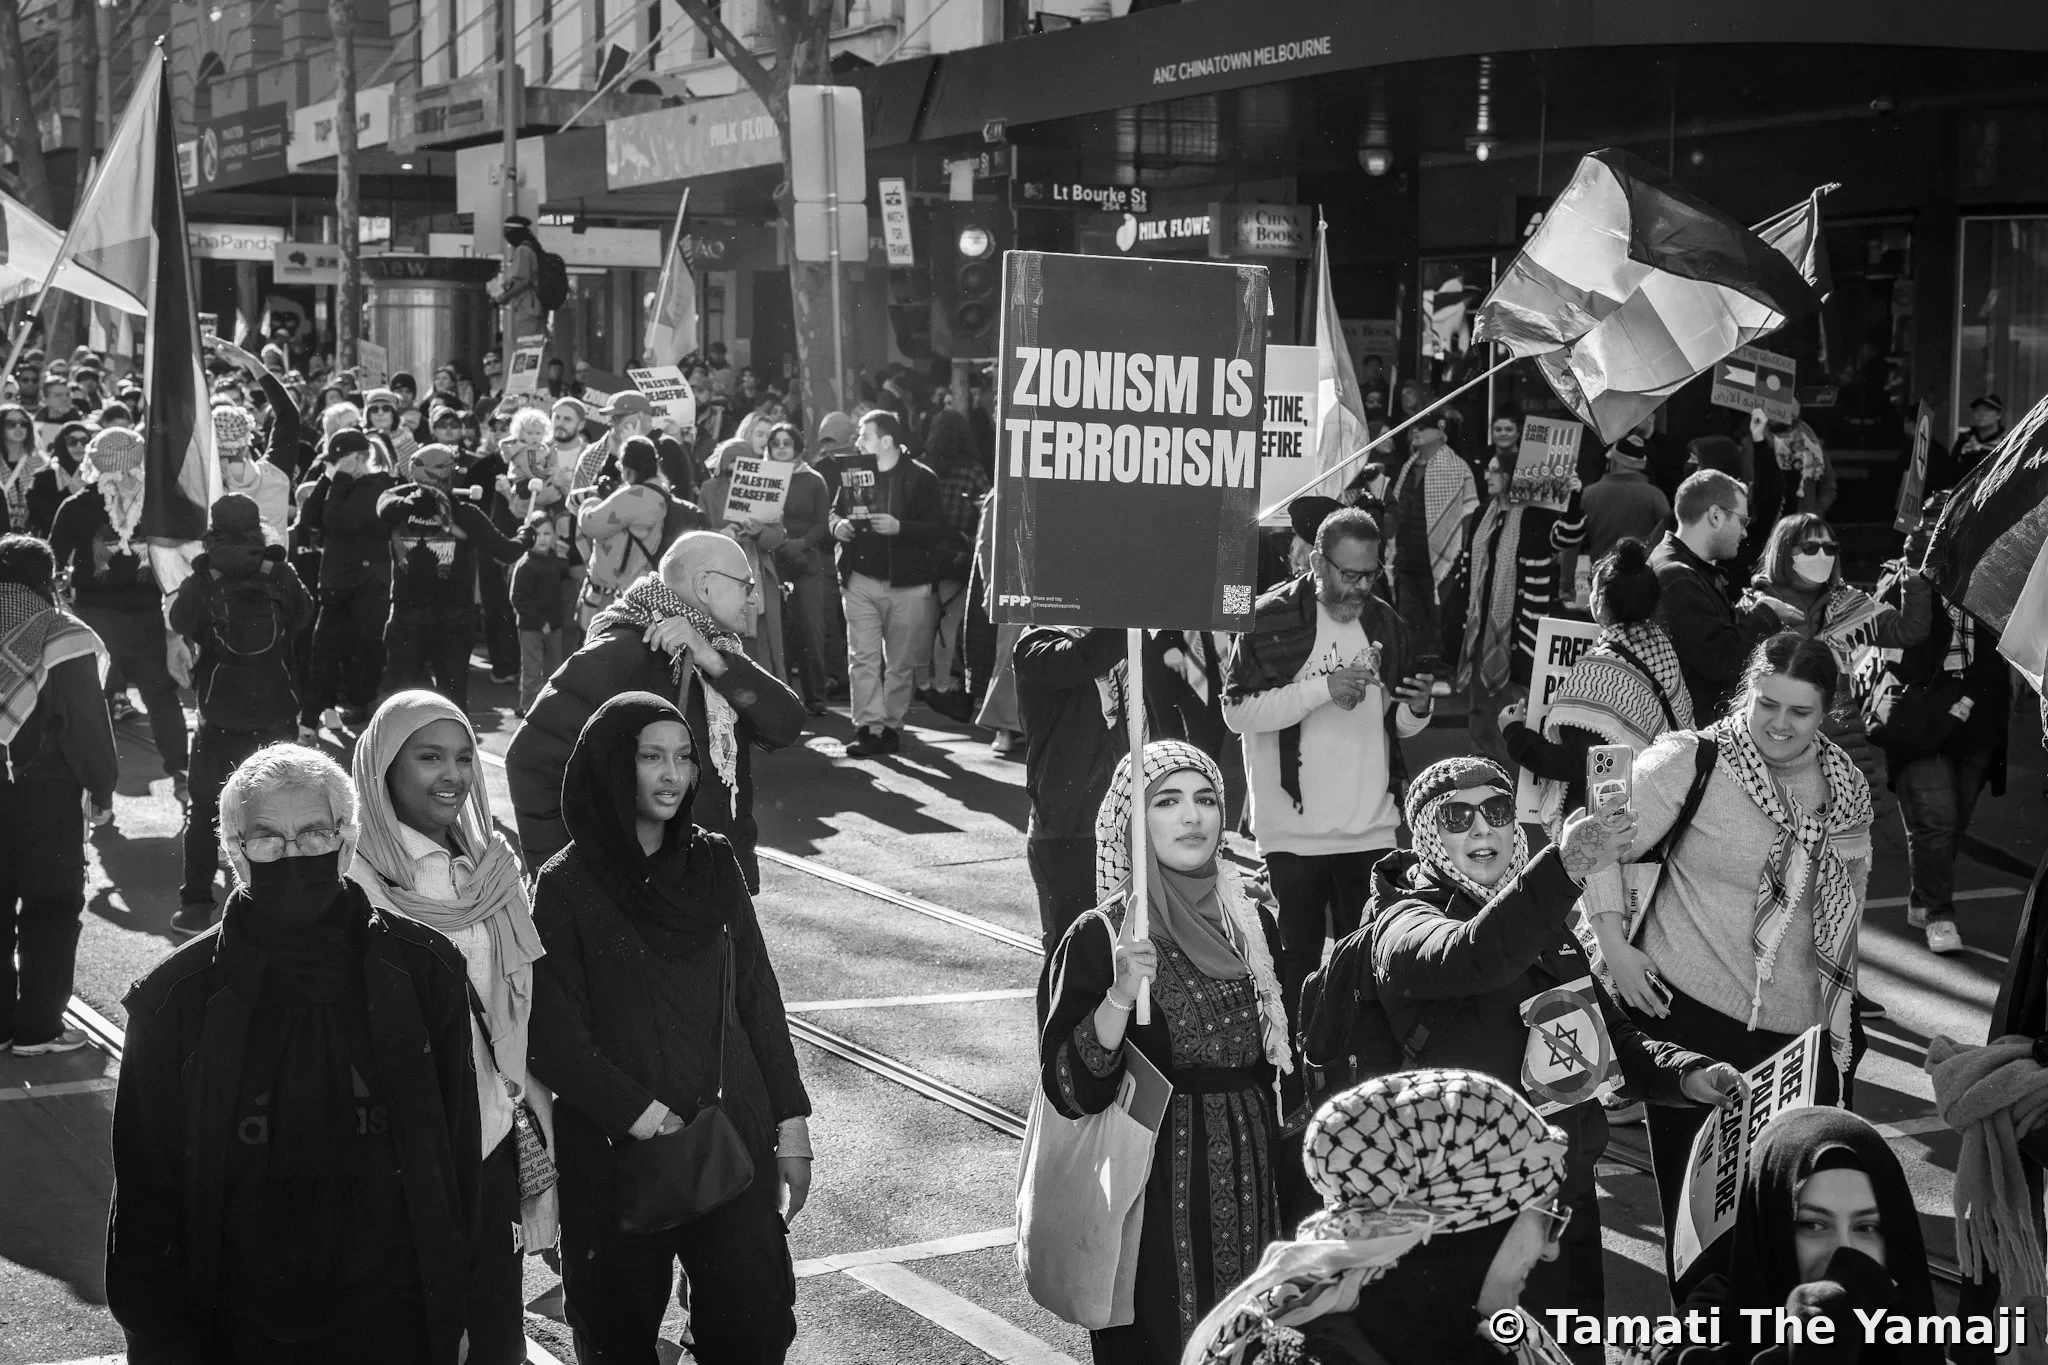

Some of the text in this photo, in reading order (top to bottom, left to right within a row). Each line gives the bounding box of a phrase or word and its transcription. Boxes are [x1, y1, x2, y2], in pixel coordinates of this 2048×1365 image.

[1152, 36, 1332, 84] ANZ CHINATOWN MELBOURNE
[710, 121, 737, 148] MILK
[1053, 184, 1147, 204] Lt Bourke St
[1138, 219, 1167, 241] MILK
[1013, 346, 1255, 418] ZIONISM IS
[1525, 432, 1548, 444] SAME
[1526, 423, 1551, 436] SAME
[1005, 418, 1255, 488] TERRORISM
[736, 460, 760, 473] FREE
[733, 474, 785, 491] PALESTINE,
[731, 487, 781, 502] CEASEFIRE
[728, 499, 752, 513] NOW.
[998, 594, 1031, 607] FPP
[1777, 1038, 1806, 1111] FREE
